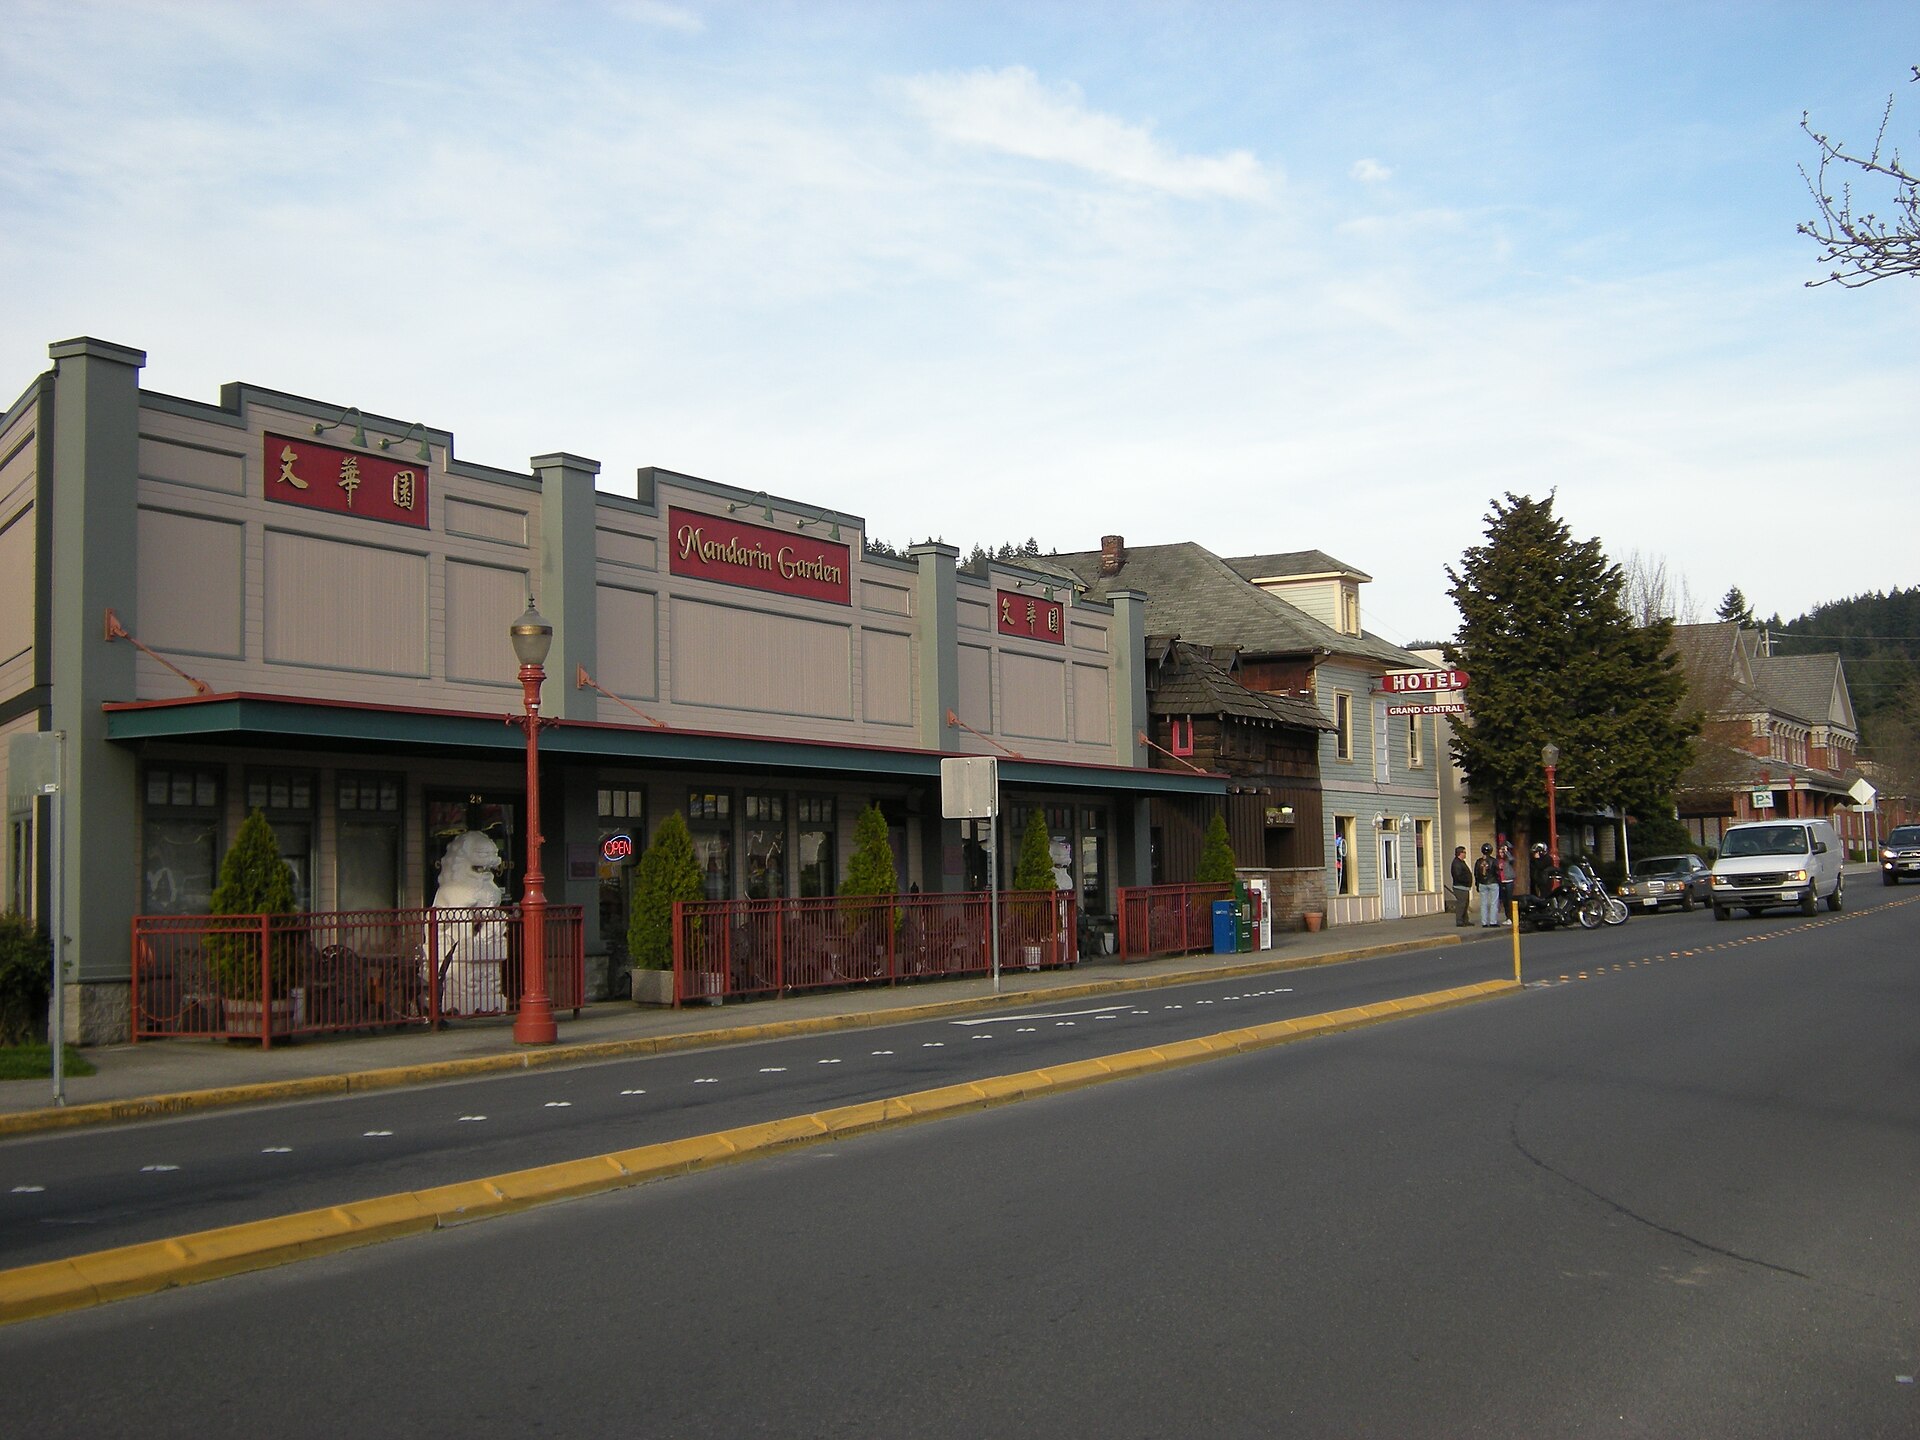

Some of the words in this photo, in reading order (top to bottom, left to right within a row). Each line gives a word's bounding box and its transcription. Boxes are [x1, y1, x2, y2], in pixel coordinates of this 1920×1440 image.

[677, 524, 772, 571] Mandarin
[778, 546, 842, 585] Garden
[1393, 672, 1462, 690] HOTEL
[1389, 706, 1421, 715] GRAND
[1422, 705, 1463, 714] CENTRAL
[1755, 794, 1765, 806] P
[604, 840, 632, 855] OPEN
